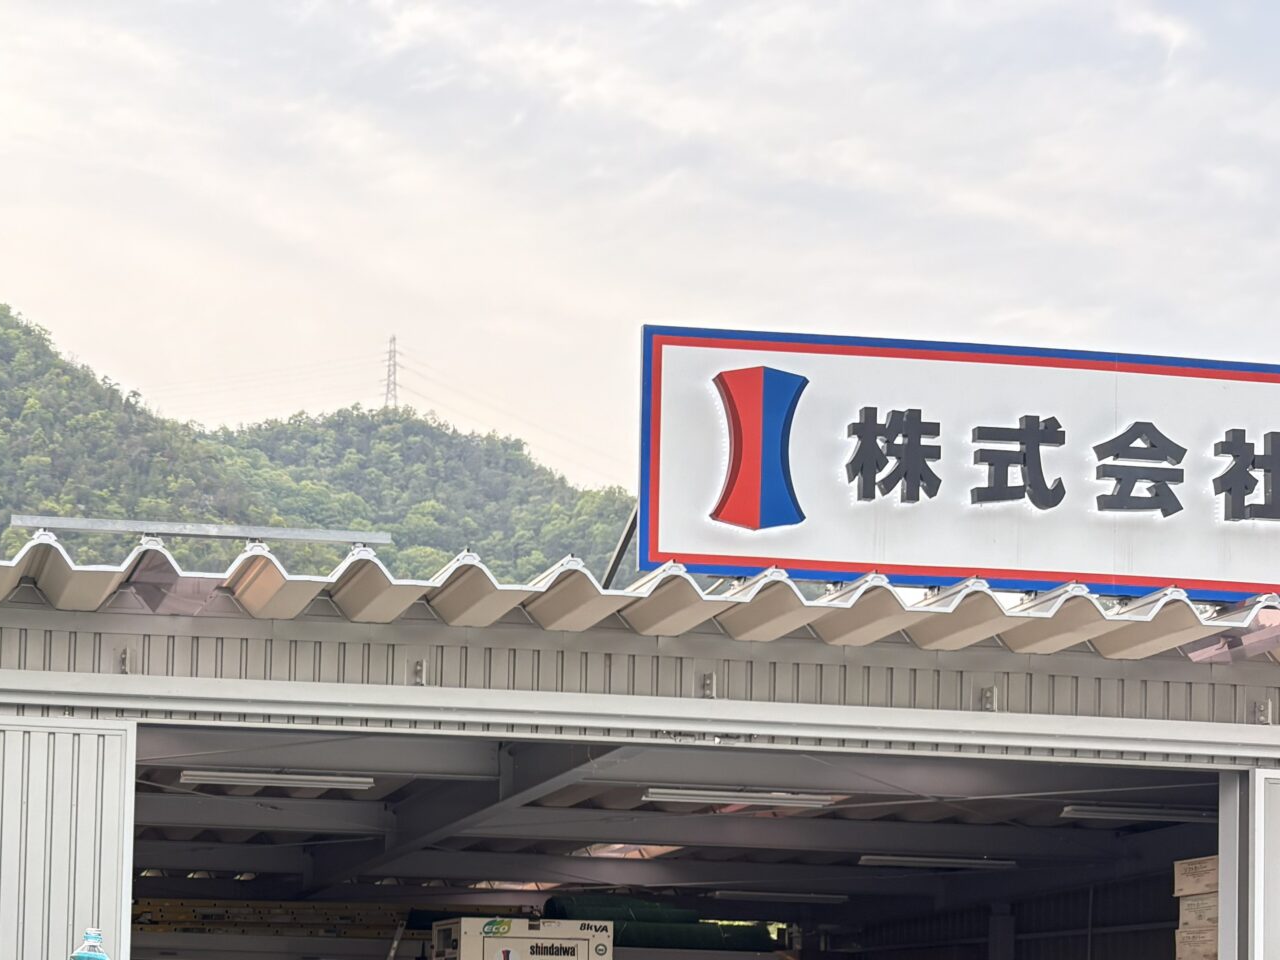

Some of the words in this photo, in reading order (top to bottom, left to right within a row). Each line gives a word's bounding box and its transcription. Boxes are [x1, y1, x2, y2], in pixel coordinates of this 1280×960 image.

[846, 406, 1280, 521] 株式会社
[529, 943, 576, 957] shindaiwa
